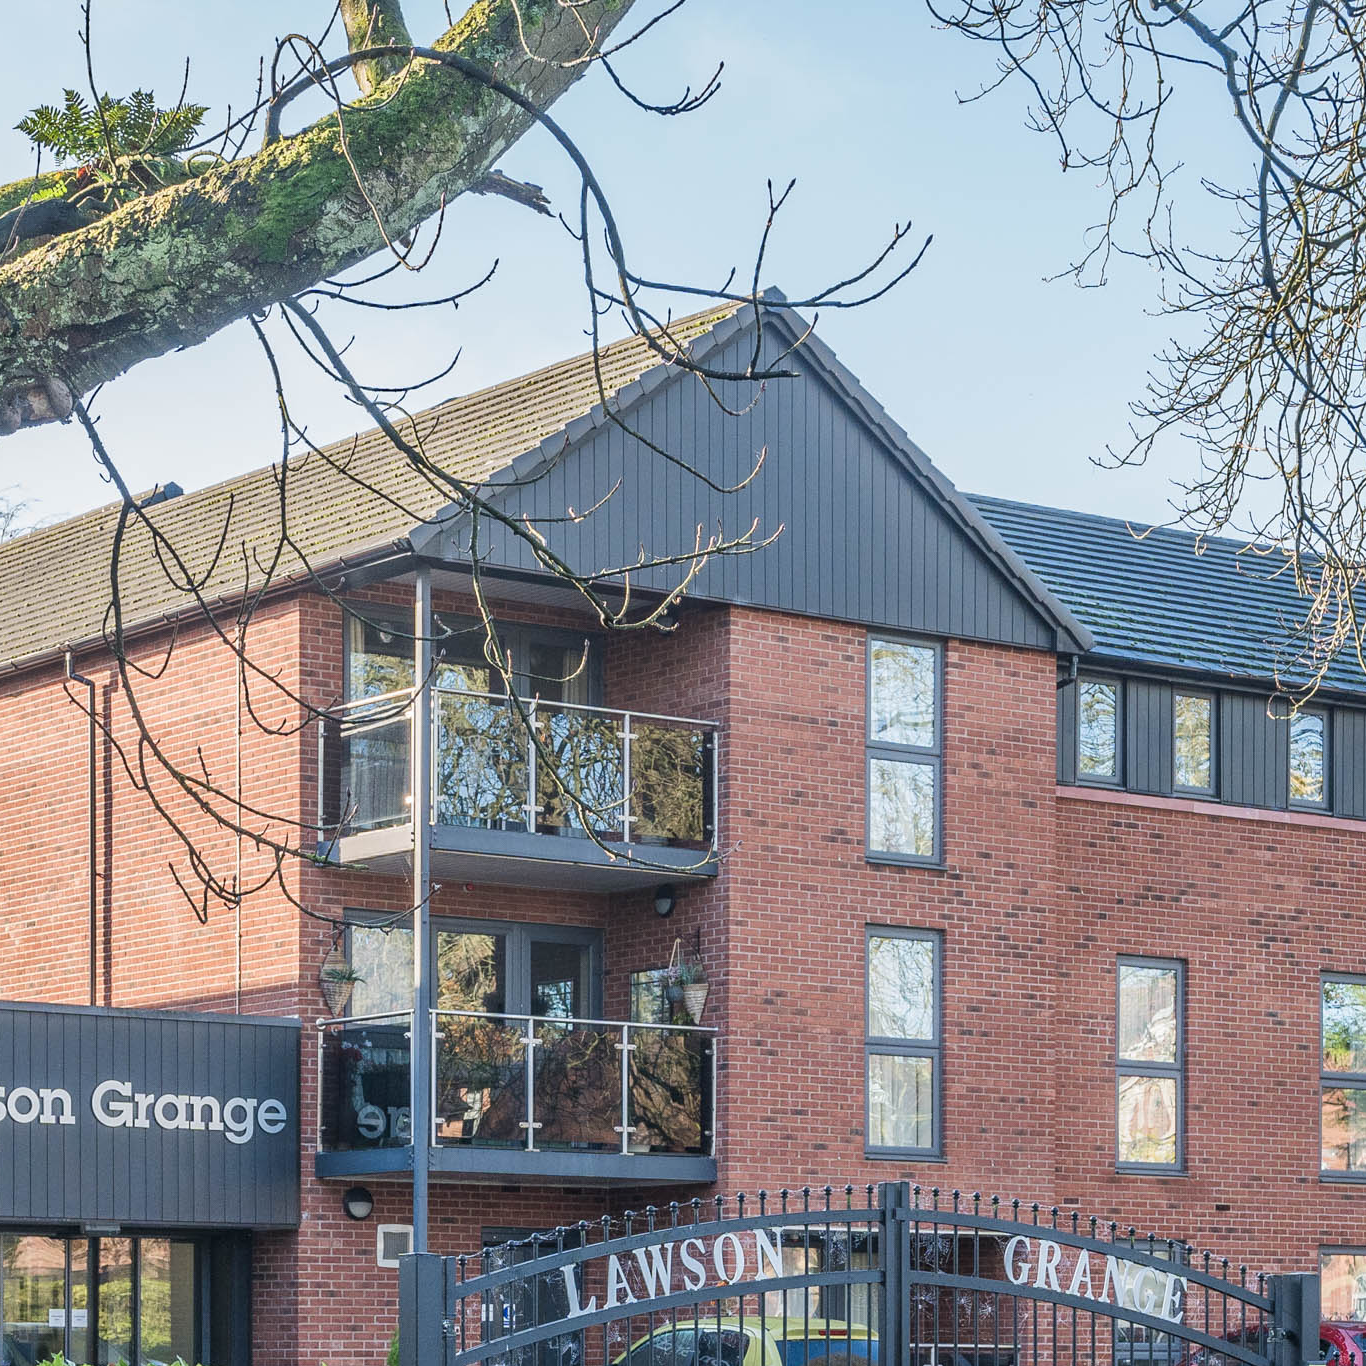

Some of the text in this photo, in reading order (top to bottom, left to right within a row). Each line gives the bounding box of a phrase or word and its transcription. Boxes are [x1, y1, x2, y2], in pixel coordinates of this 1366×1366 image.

[91, 1079, 287, 1144] Grange
[559, 1226, 1188, 1324] LAWSON GRANGE
